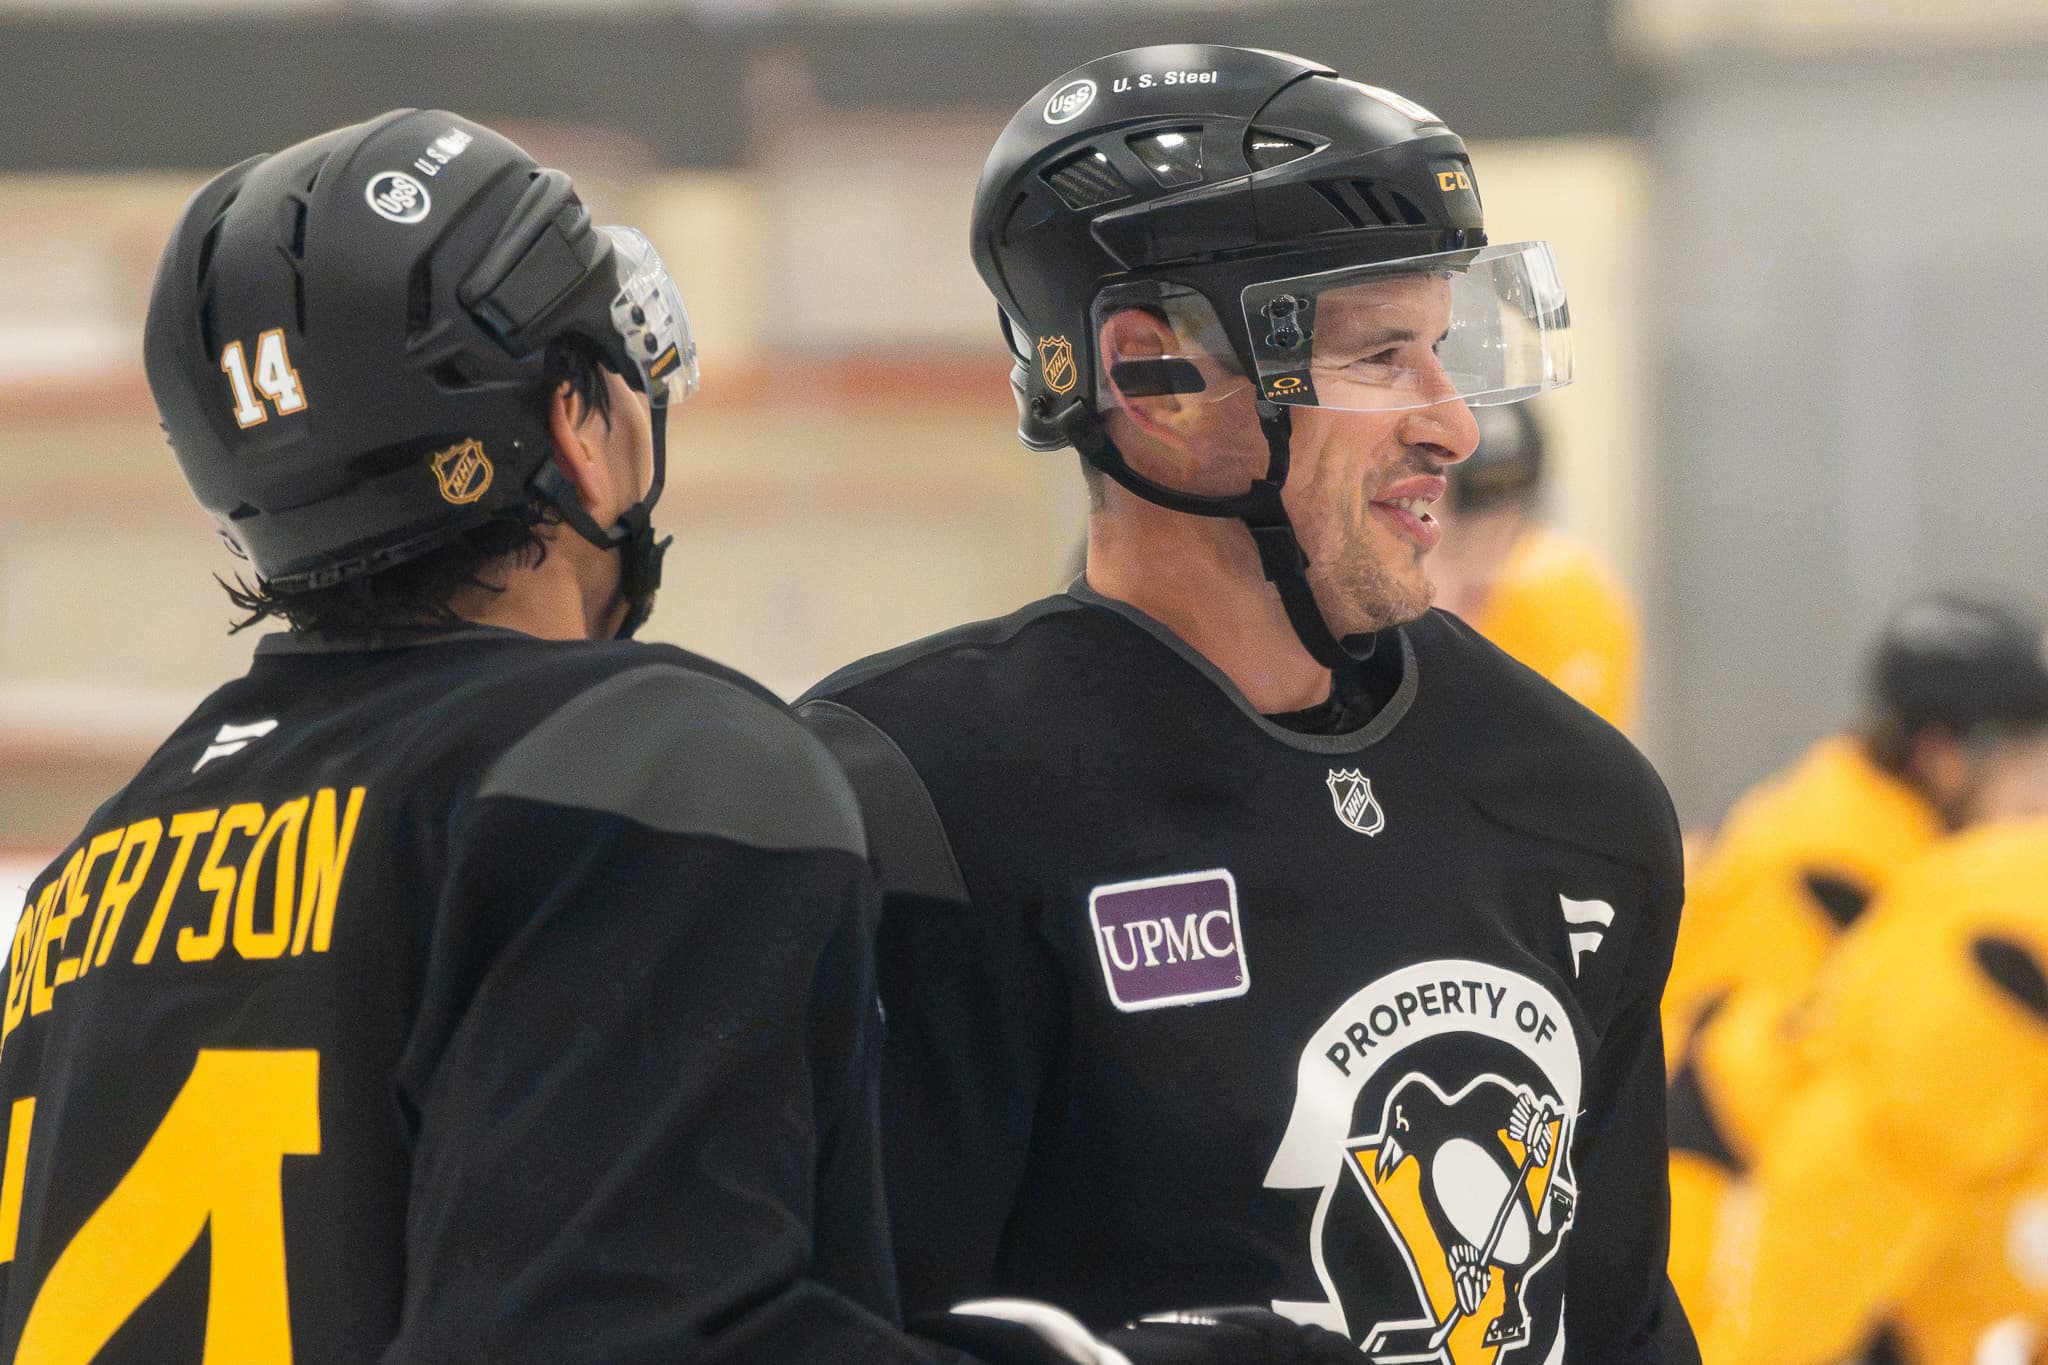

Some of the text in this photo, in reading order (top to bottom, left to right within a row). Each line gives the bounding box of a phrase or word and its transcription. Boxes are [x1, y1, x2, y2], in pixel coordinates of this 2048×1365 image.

[1051, 85, 1090, 114] USS
[1112, 71, 1217, 93] U. S. Steel
[376, 176, 418, 214] USS
[1436, 171, 1470, 192] CC
[221, 327, 308, 429] 14
[1345, 786, 1366, 822] NHL
[1101, 909, 1235, 972] UPMC
[1326, 980, 1558, 1077] PROPERTY OF
[0, 1048, 320, 1365] 4
